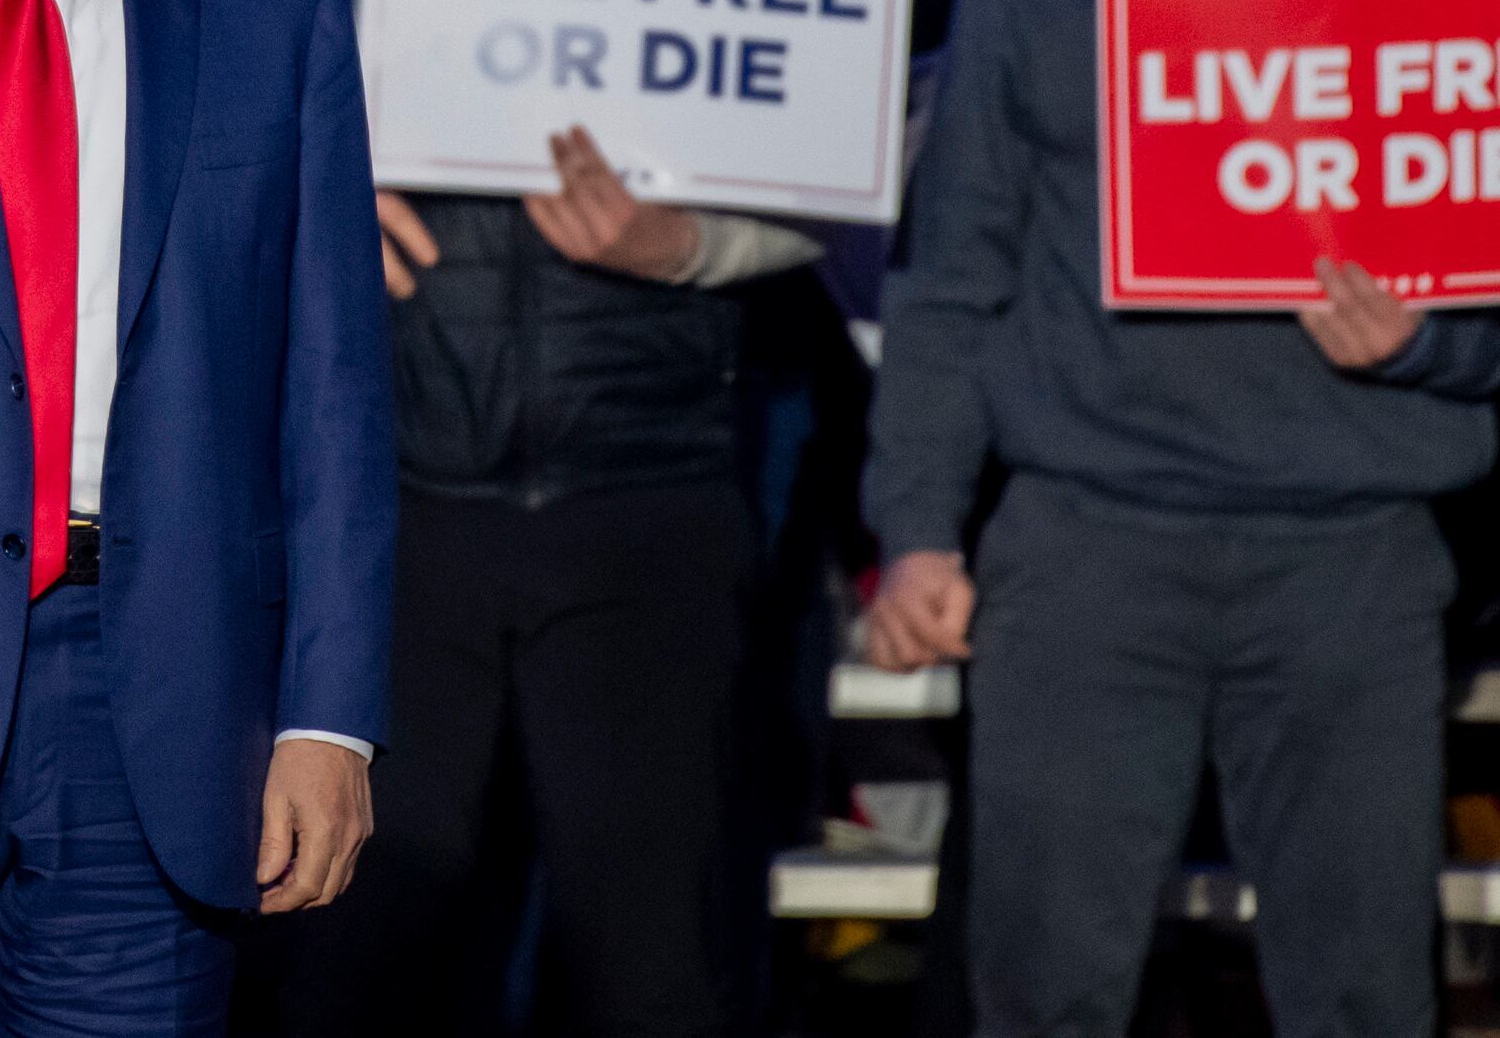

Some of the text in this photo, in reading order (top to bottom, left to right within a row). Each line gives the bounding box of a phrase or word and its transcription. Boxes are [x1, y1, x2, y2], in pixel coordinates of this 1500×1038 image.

[475, 19, 788, 104] OR DIE
[1138, 37, 1500, 124] LIVE FR
[1216, 137, 1360, 214] OR
